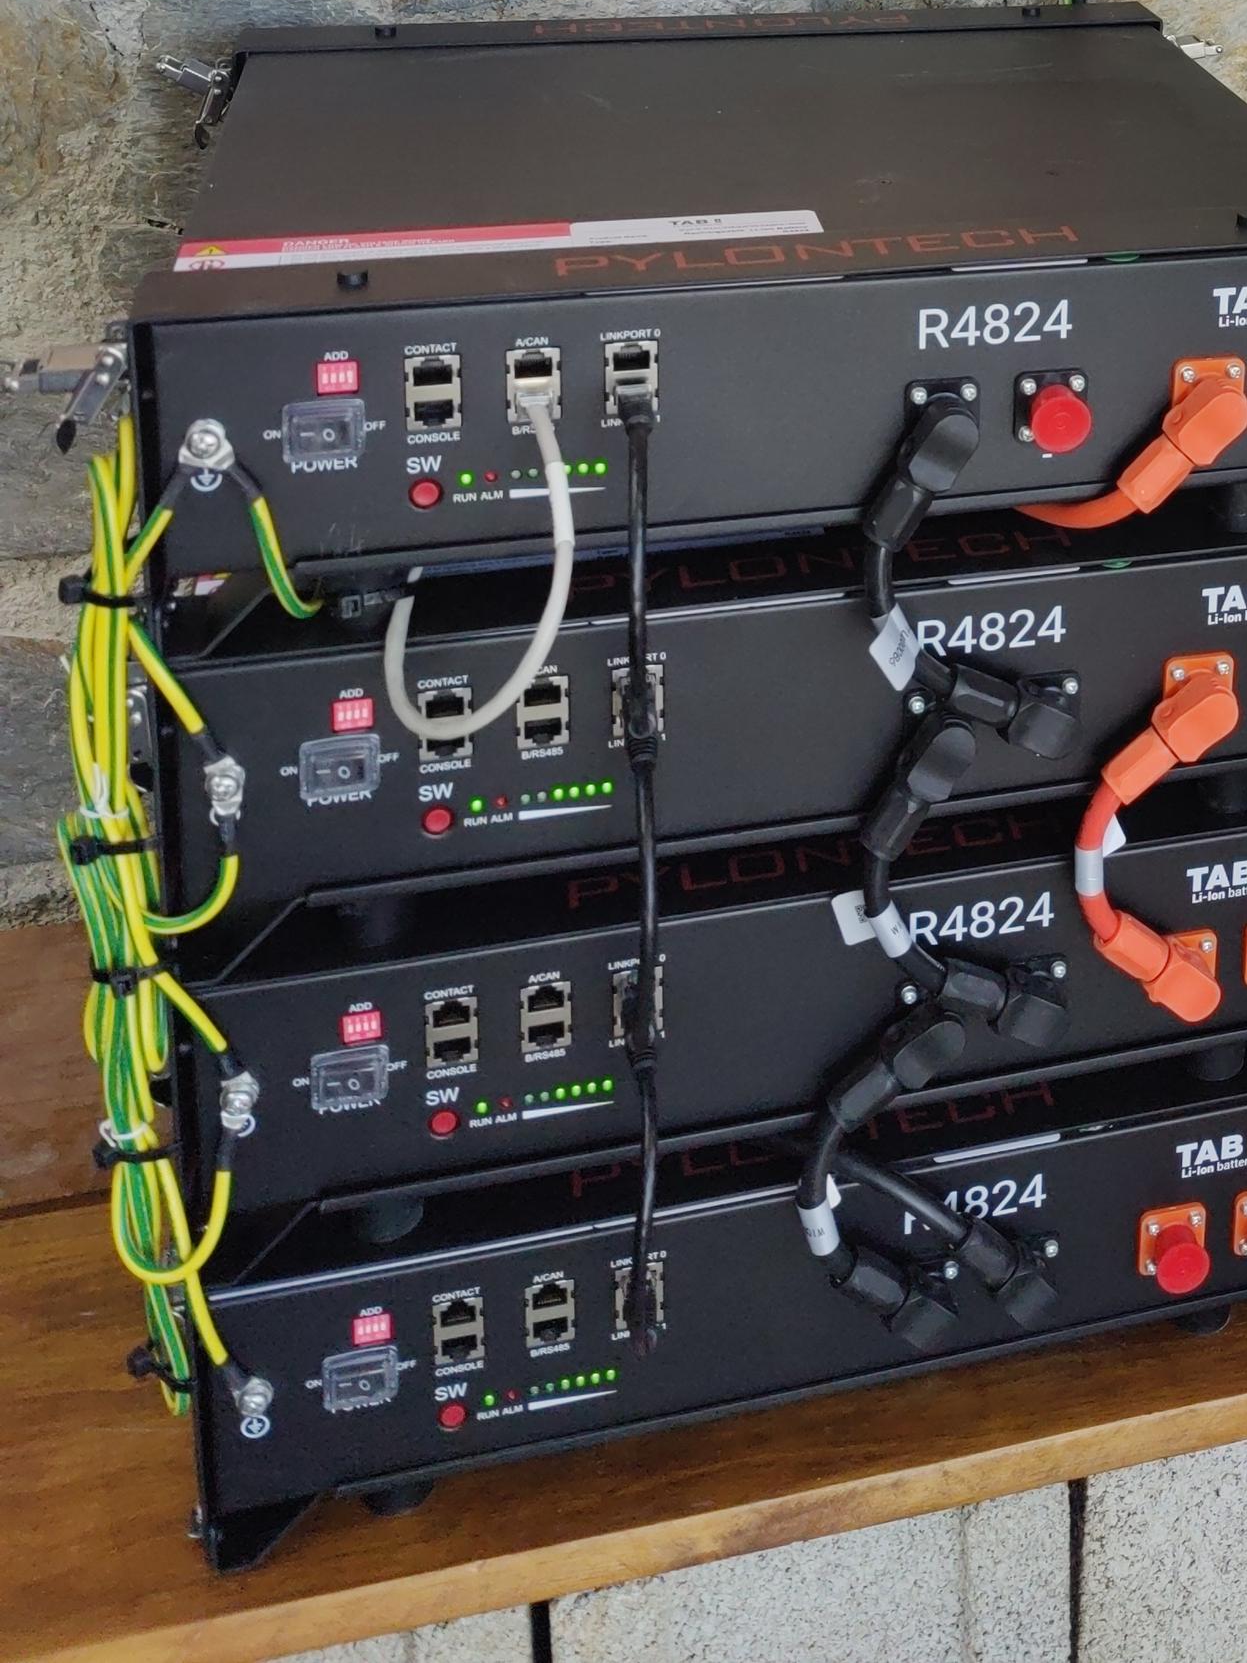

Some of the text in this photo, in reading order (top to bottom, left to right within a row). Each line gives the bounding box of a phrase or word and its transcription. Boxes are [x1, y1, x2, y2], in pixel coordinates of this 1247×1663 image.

[555, 225, 1080, 277] PYLONTECH
[918, 299, 1073, 350] R4824
[515, 337, 549, 347] A/CAN
[600, 329, 661, 341] LINKPORT 0
[324, 351, 349, 361] ADD
[404, 342, 457, 356] CONTACT
[363, 420, 386, 432] OFF
[263, 429, 282, 440] ON
[407, 431, 460, 445] CONSOLE
[405, 455, 442, 474] SW
[453, 490, 504, 503] RUN ALM
[1207, 613, 1242, 626] Li-Ion
[916, 605, 1066, 655] R4824
[660, 652, 667, 661] 0
[417, 674, 469, 689] CONTACT
[339, 688, 364, 699] ADD
[377, 752, 399, 764] OFF
[521, 748, 564, 761] B/RS485
[280, 766, 298, 777] ON
[419, 759, 472, 774] CONSOLE
[418, 782, 454, 803] SW
[464, 813, 513, 827] RUN ALM
[1191, 891, 1226, 904] Li-Ion
[909, 891, 1056, 947] R4824
[528, 970, 560, 984] A/CAN
[424, 984, 475, 1001] CONTACT
[349, 1001, 373, 1013] ADD
[525, 1048, 566, 1063] B/RS485
[386, 1060, 408, 1072] OFF
[426, 1064, 478, 1080] CONSOLE
[292, 1077, 310, 1088] ON
[425, 1087, 460, 1107] SW
[469, 1112, 517, 1128] RUN ALM
[1175, 1133, 1244, 1168] TAB
[1181, 1165, 1215, 1179] Li-Ion
[904, 1173, 1047, 1235] 4824
[532, 1271, 564, 1285] A/CAN
[432, 1286, 481, 1304] CONTACT
[359, 1306, 383, 1317] ADD
[530, 1343, 570, 1358] B/RS485
[434, 1360, 484, 1377] CONSOLE
[305, 1379, 323, 1389] ON
[434, 1382, 468, 1402] SW
[476, 1404, 524, 1421] RUN ALM
